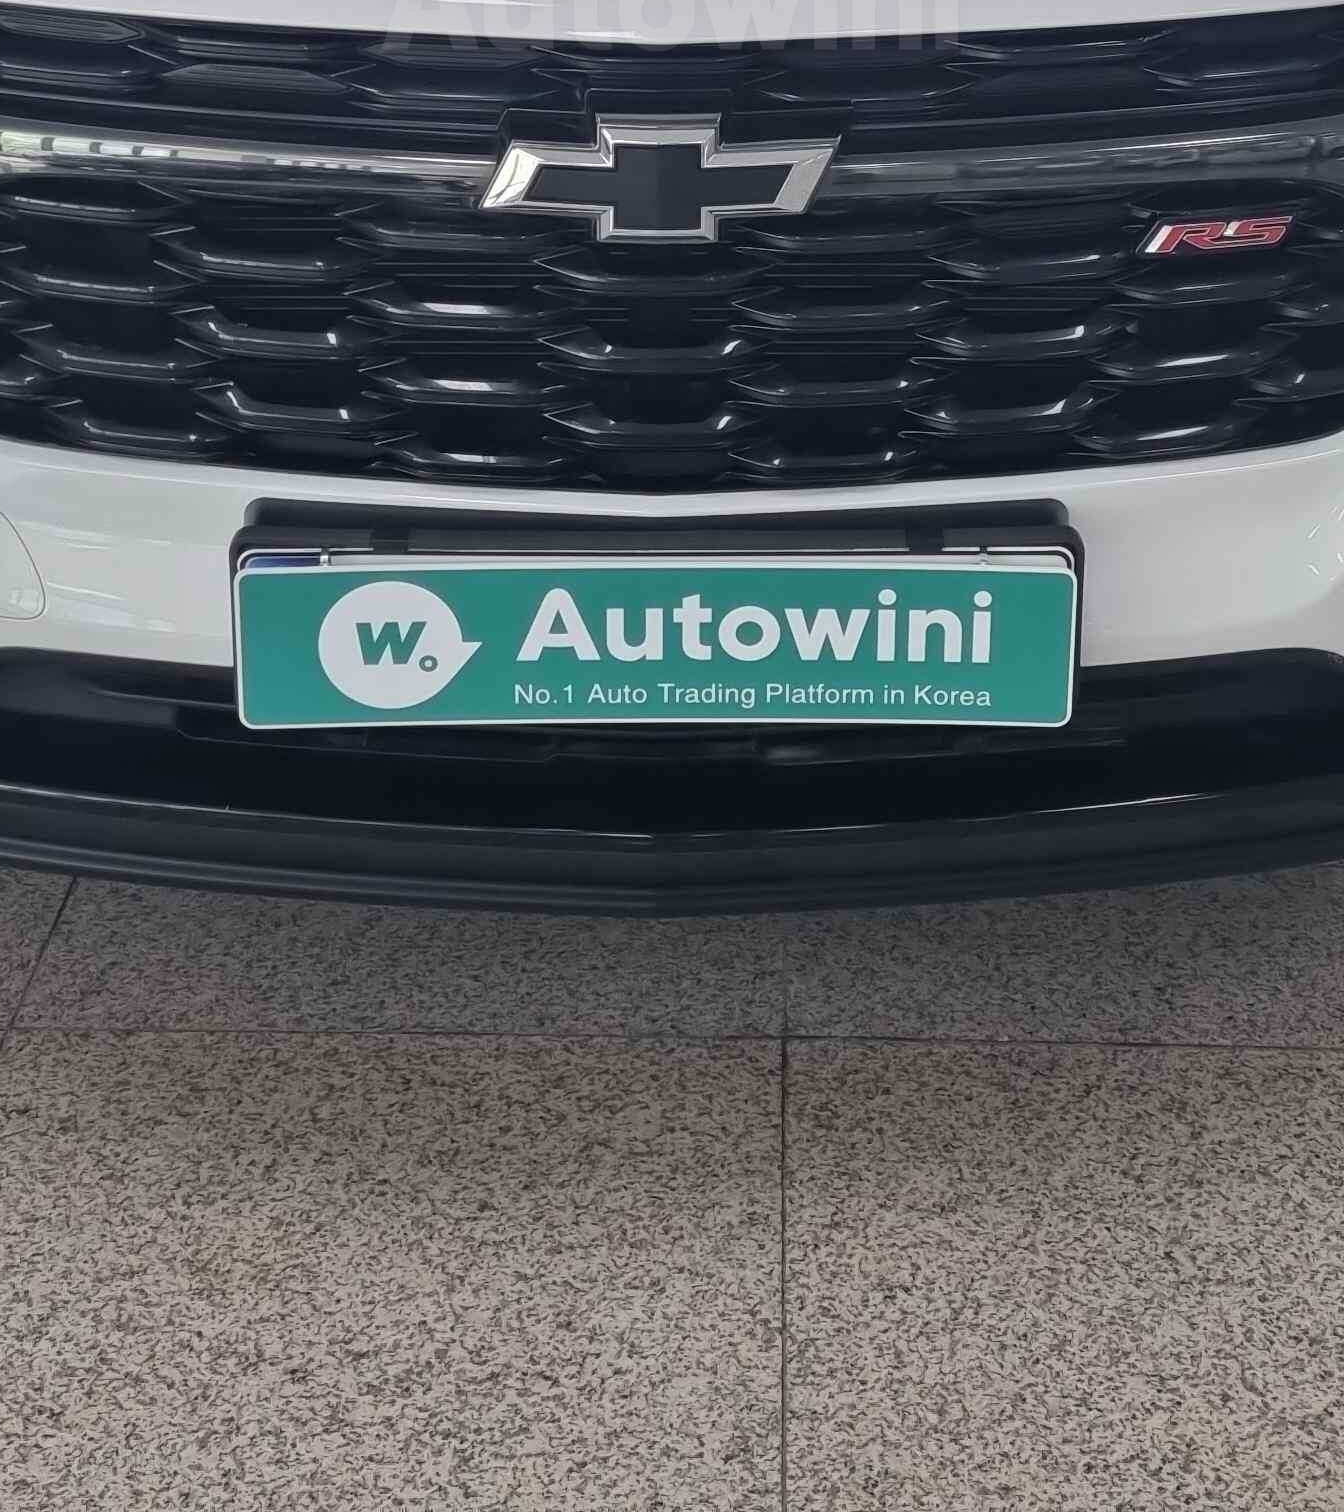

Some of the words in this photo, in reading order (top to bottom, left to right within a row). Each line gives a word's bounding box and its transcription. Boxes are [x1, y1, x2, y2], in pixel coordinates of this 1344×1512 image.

[1144, 215, 1295, 253] RS
[515, 587, 993, 664] Autowini
[514, 683, 572, 705] No.1
[587, 683, 648, 705] Auto
[657, 683, 755, 709] Trading
[766, 683, 874, 705] Platform
[883, 685, 905, 705] in
[914, 685, 991, 706] Korea
